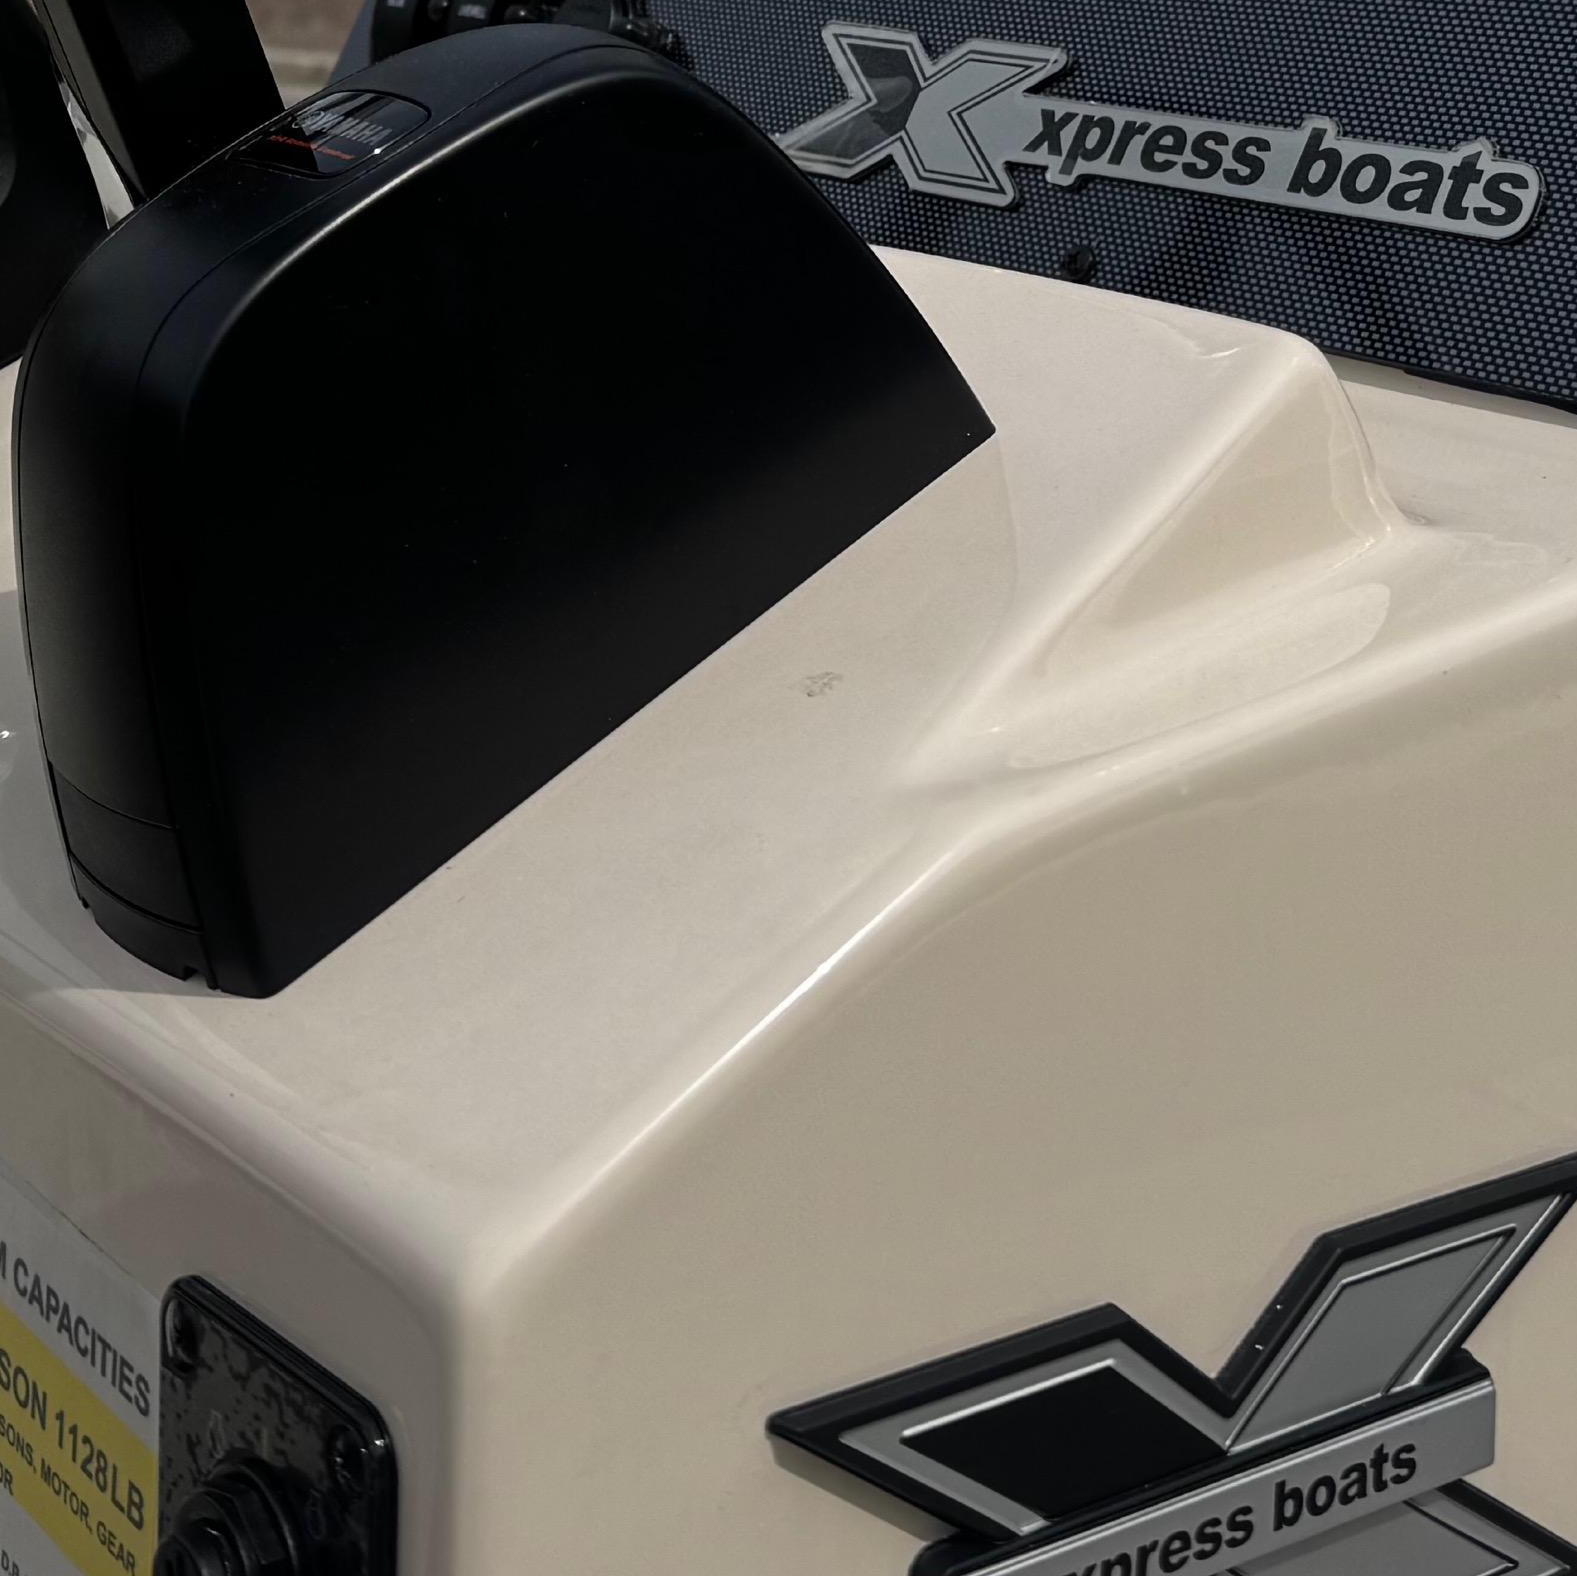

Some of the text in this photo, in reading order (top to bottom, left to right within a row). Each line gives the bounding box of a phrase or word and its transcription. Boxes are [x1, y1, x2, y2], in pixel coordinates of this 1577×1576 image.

[1023, 108, 1271, 176] xpress
[1287, 127, 1530, 227] boats
[13, 1257, 151, 1417] CAPACITIES
[40, 1458, 94, 1535] MOTOR,
[96, 1520, 137, 1576] GEAR
[1271, 1442, 1419, 1533] boats
